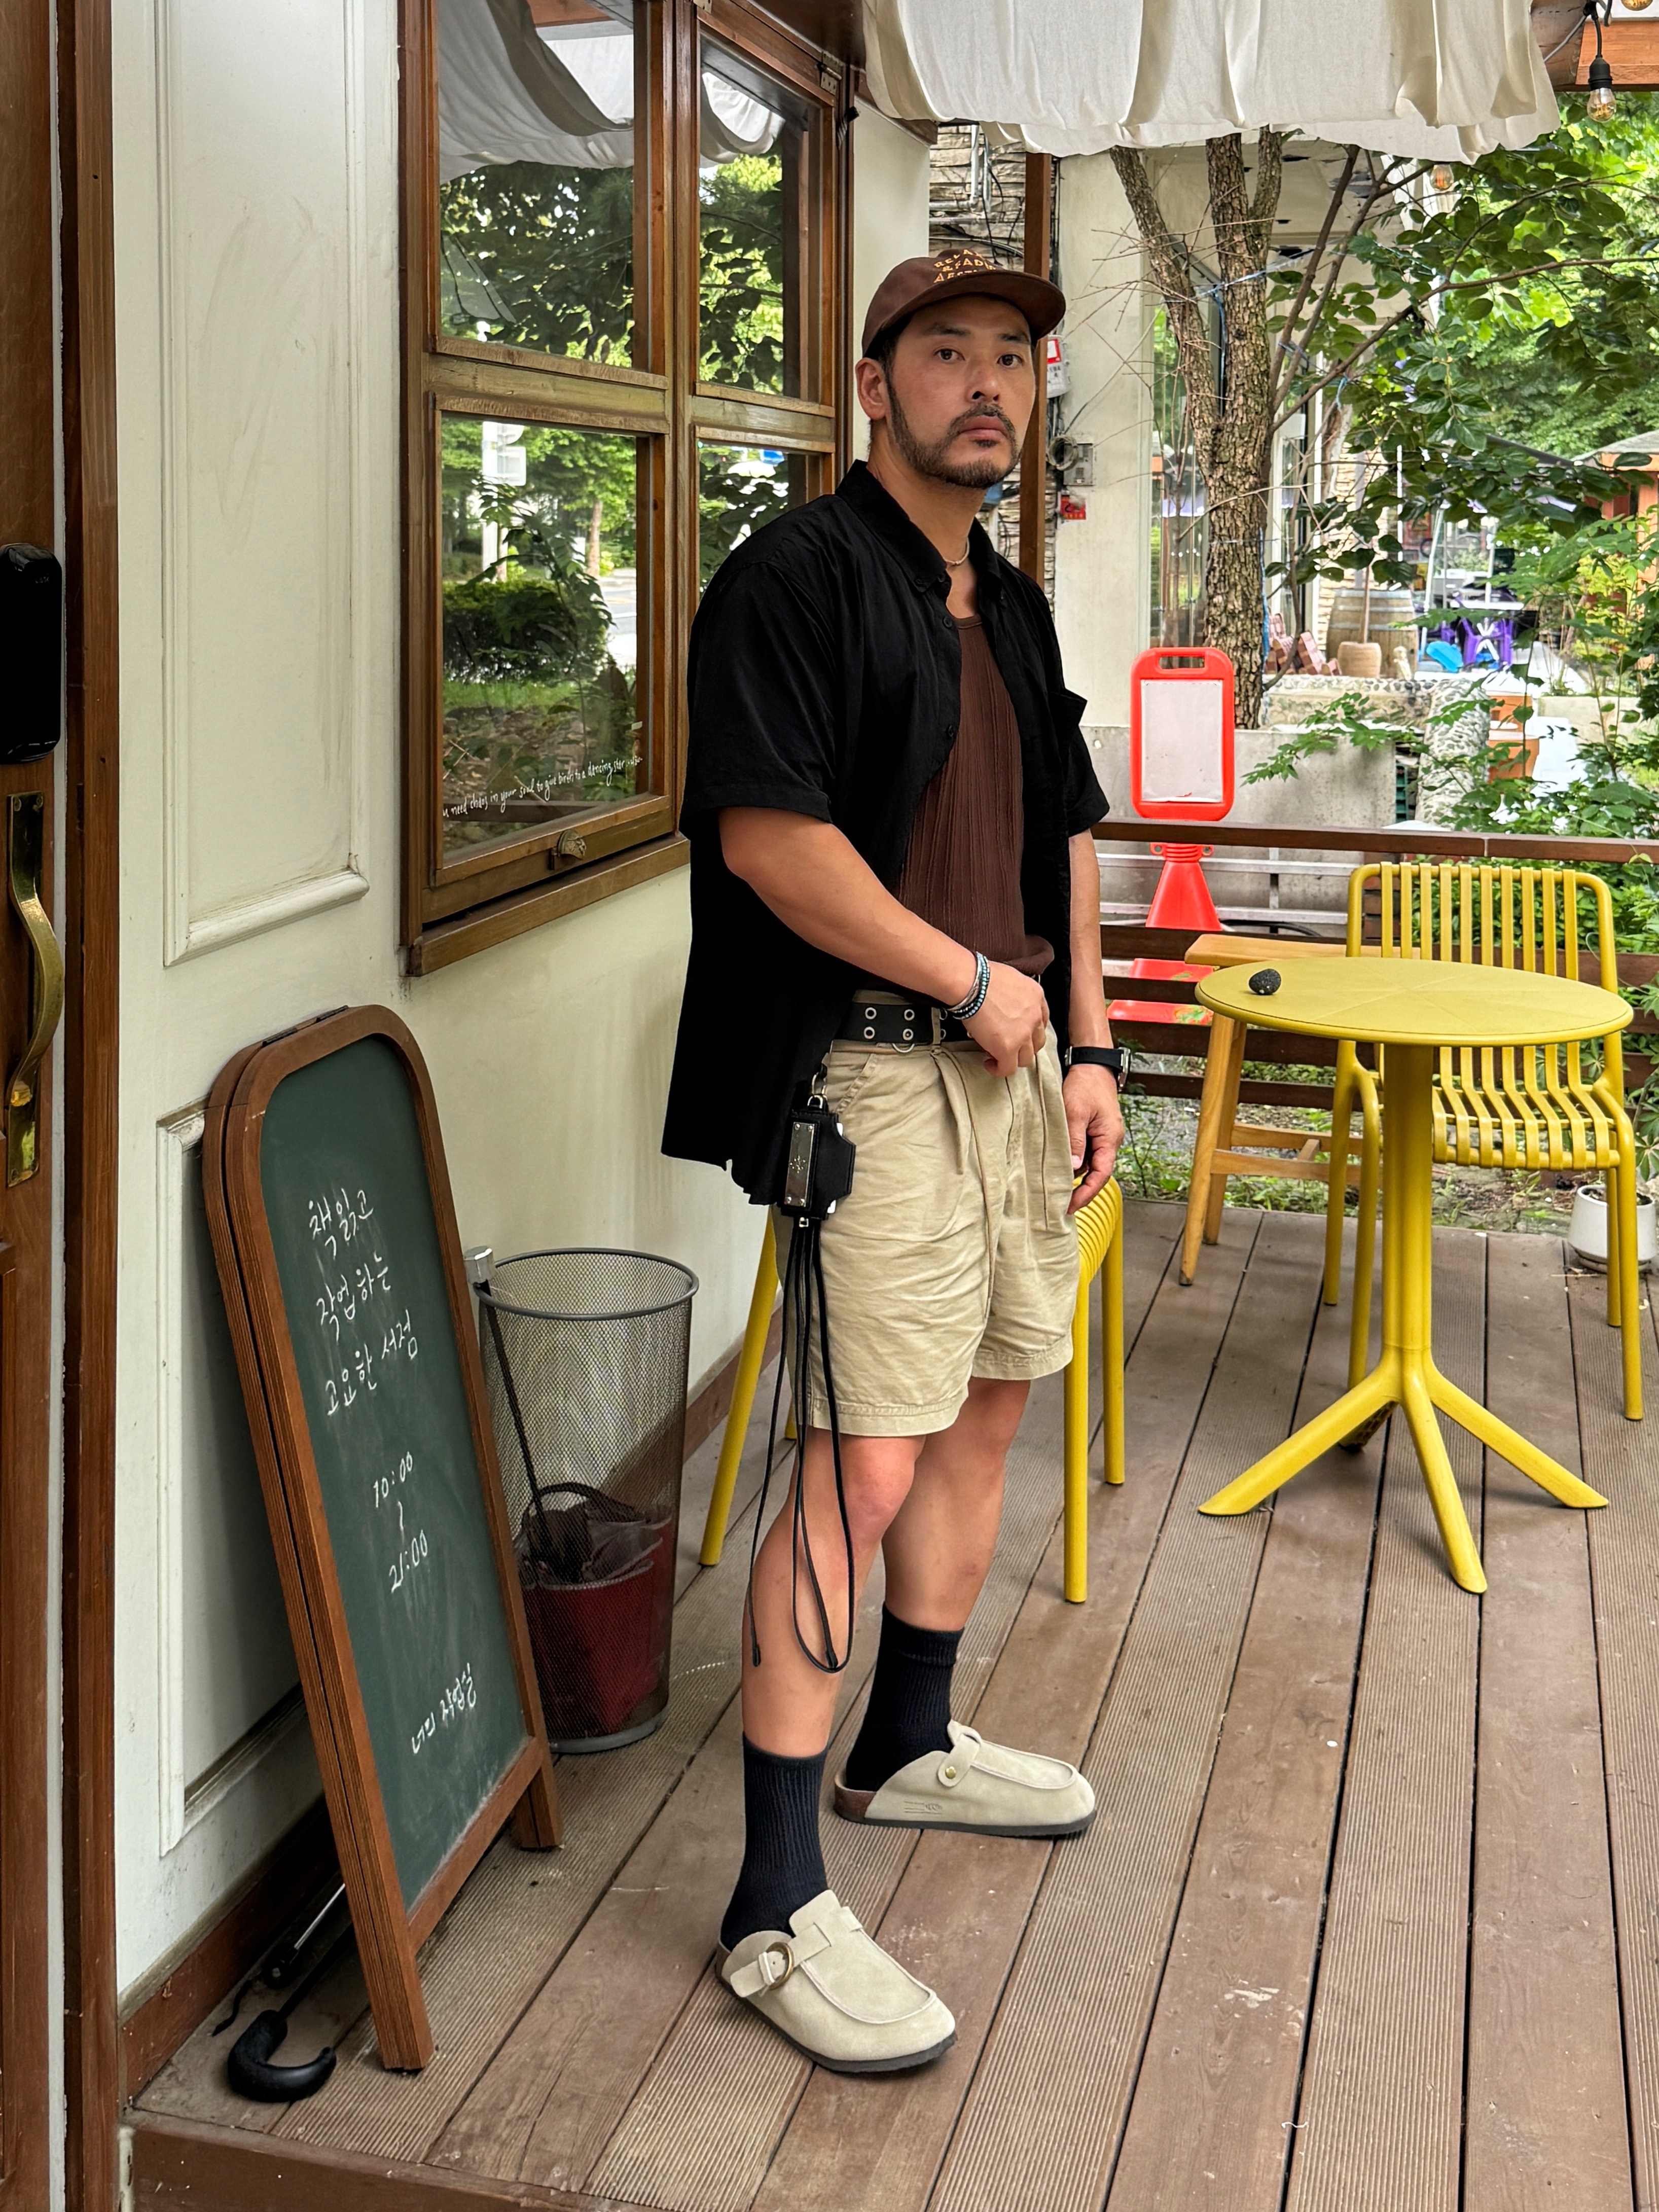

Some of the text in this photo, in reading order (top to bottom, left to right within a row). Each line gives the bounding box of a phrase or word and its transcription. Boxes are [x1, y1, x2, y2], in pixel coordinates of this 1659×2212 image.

[451, 797, 468, 815] need
[470, 793, 488, 810] chaos
[490, 791, 498, 802] in
[500, 789, 517, 813] your
[519, 778, 534, 798] soul
[536, 780, 544, 793] to
[545, 775, 557, 801] give
[558, 769, 574, 785] birth
[574, 768, 581, 780] to
[582, 770, 587, 779] a
[588, 759, 614, 787] dancing
[614, 758, 625, 773] star
[316, 1250, 391, 1345] 작업하는
[326, 1309, 418, 1415] 고요한 서점
[373, 1451, 413, 1508] 10:00
[389, 1529, 428, 1594] 21:00
[440, 1662, 477, 1721] 작업실
